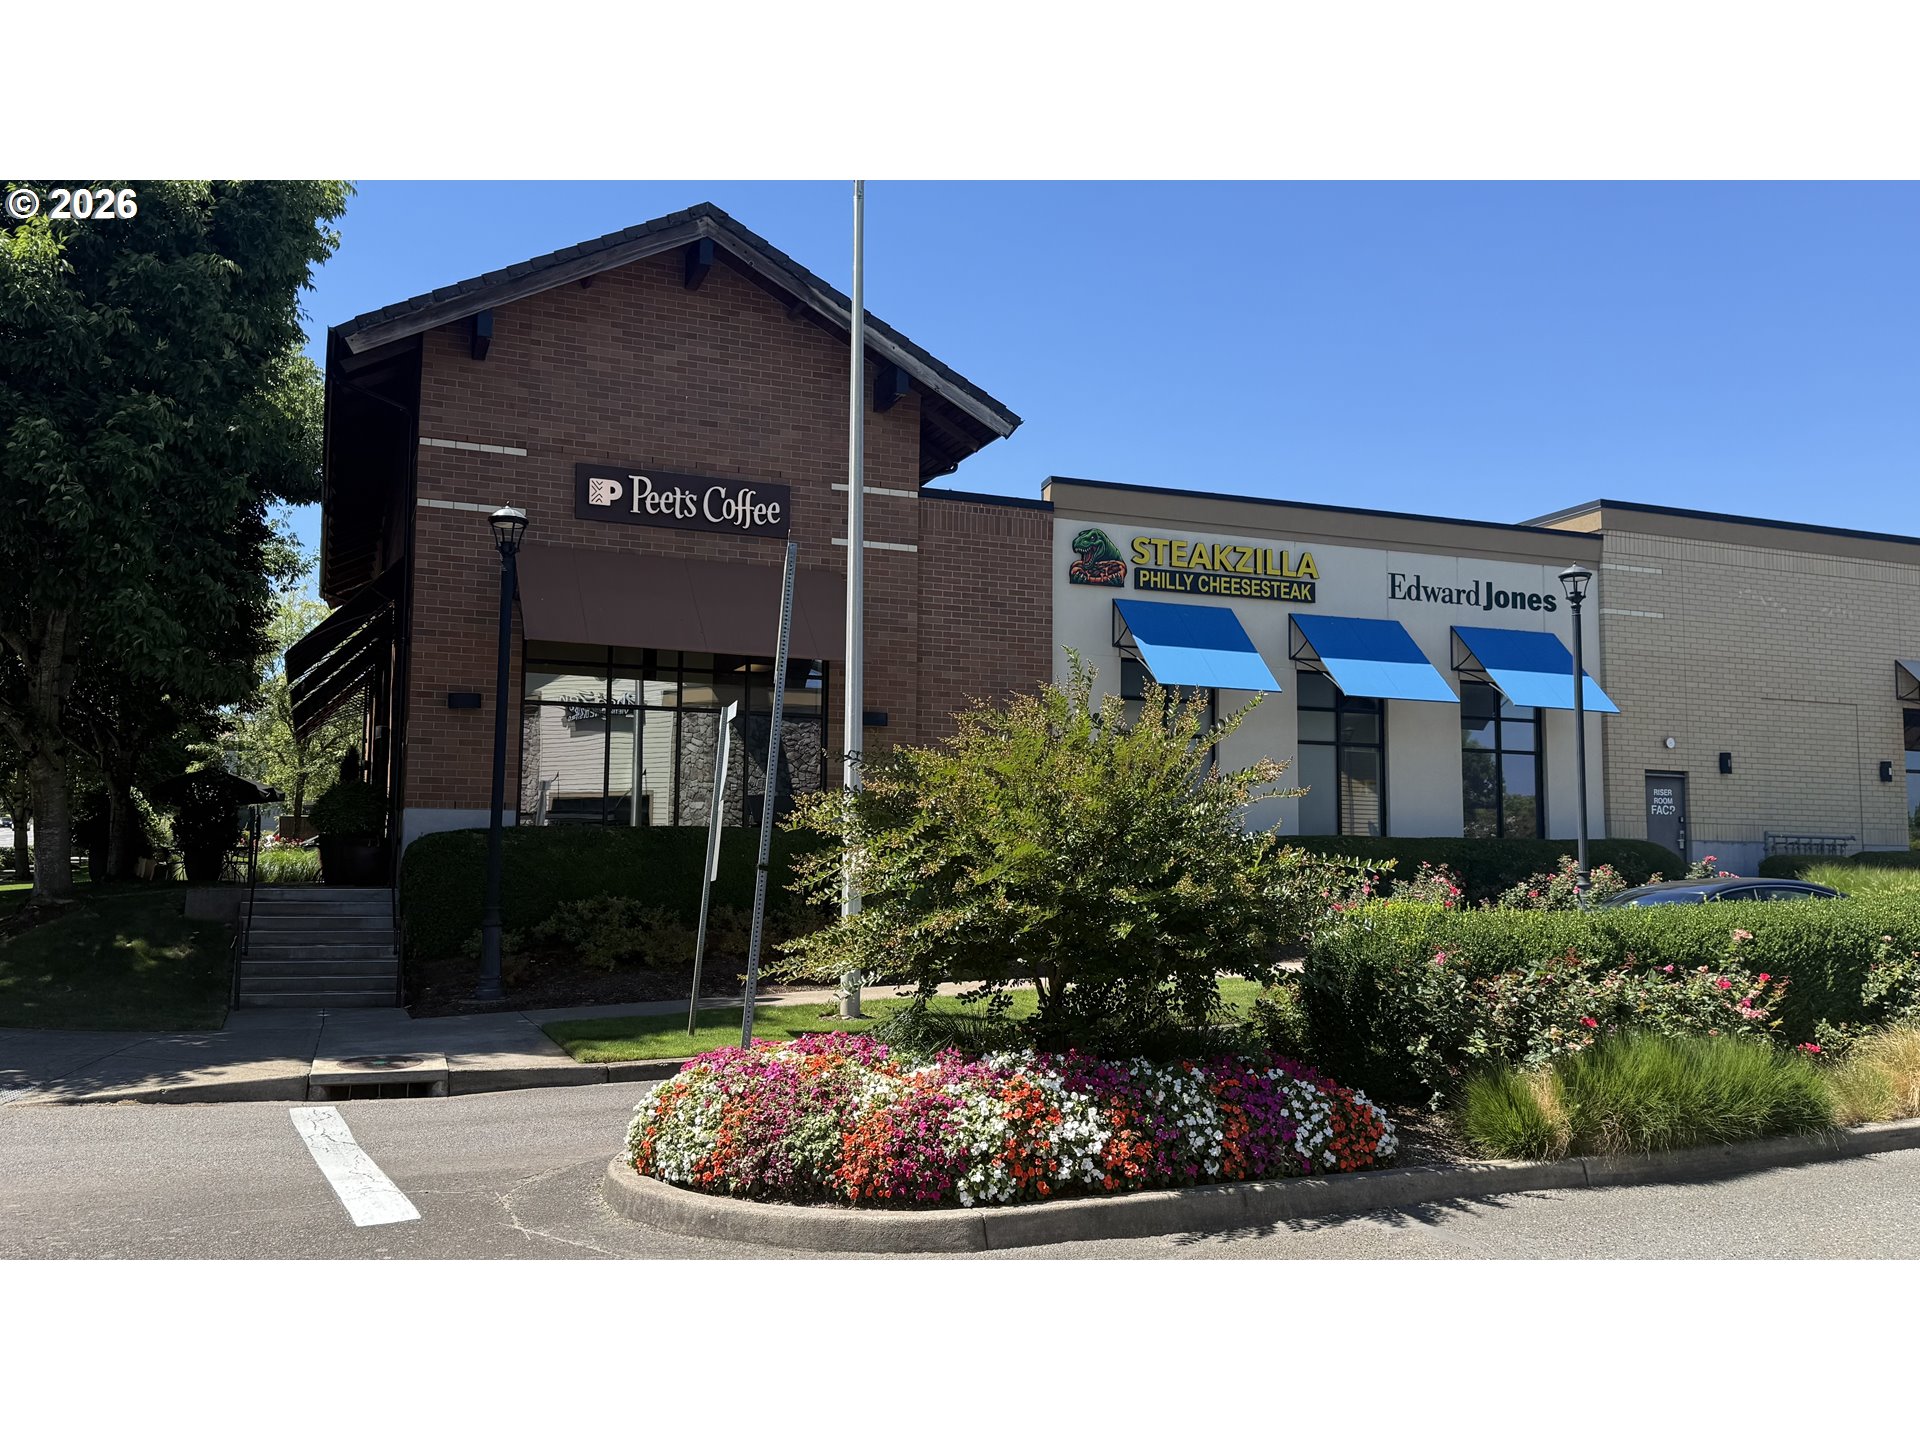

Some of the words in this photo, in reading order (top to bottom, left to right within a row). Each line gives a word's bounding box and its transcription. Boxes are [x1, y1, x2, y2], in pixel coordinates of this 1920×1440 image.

[629, 475, 698, 519] Peet's
[703, 486, 781, 529] Coffee
[1132, 537, 1319, 579] STEAKZILLA
[1139, 571, 1194, 591] PHILLY
[1198, 576, 1312, 601] CHEESESTEAK
